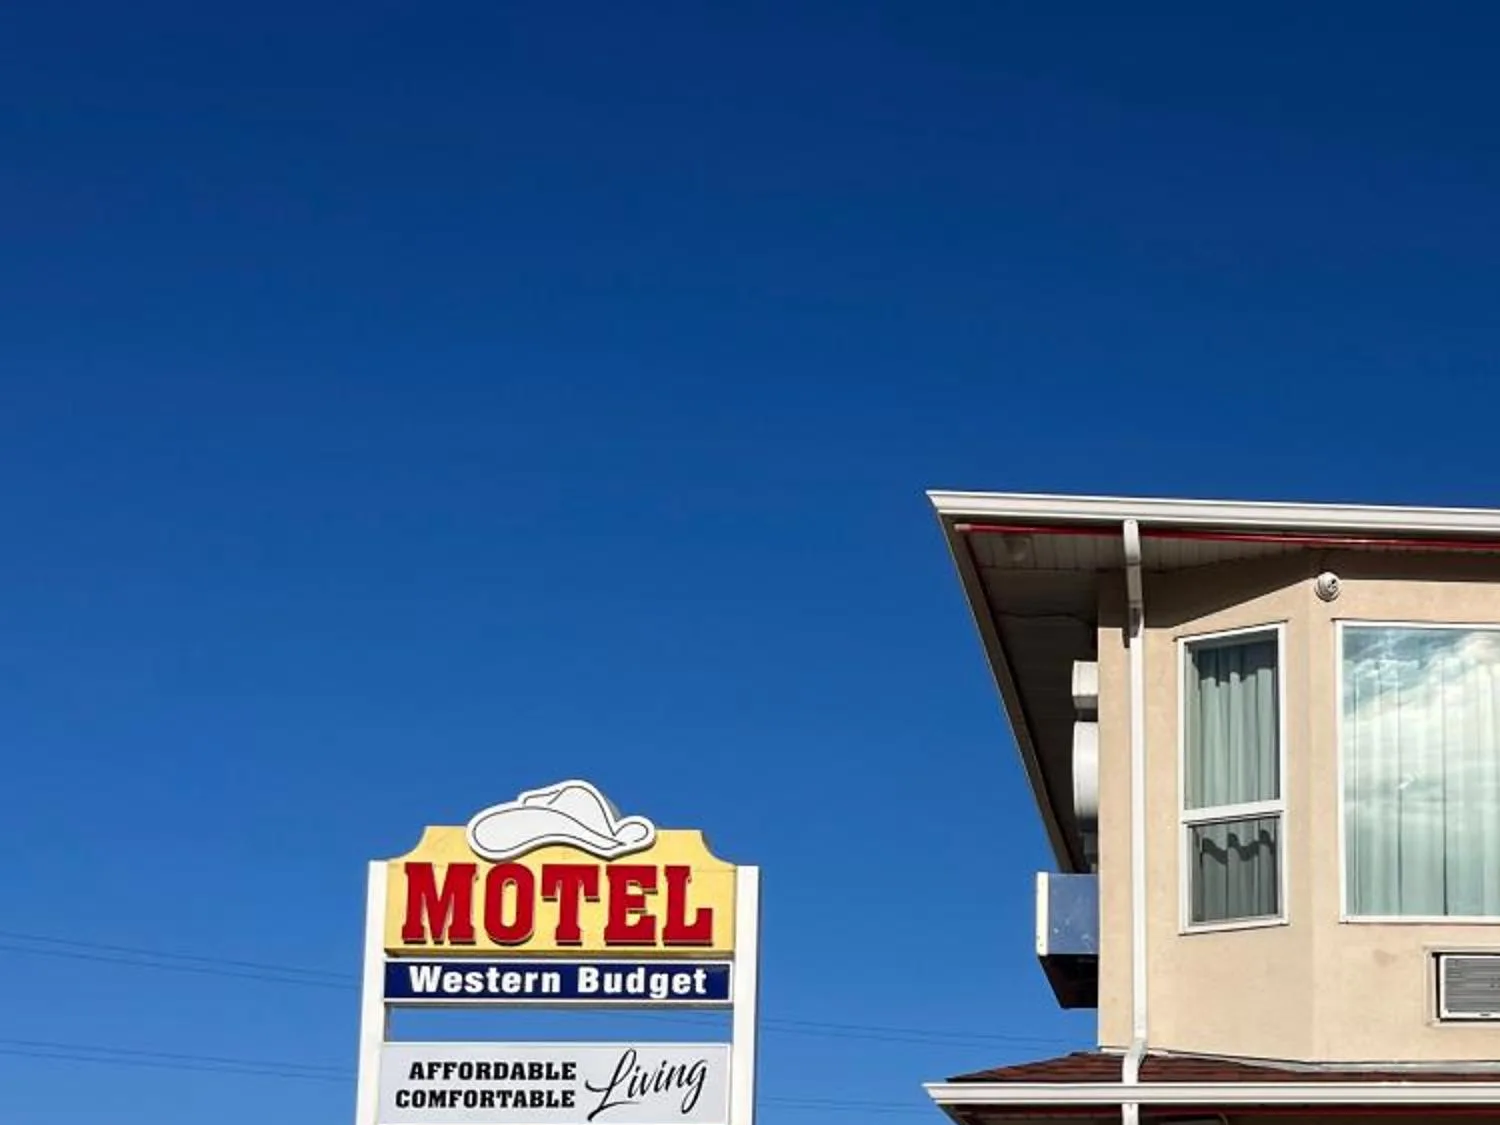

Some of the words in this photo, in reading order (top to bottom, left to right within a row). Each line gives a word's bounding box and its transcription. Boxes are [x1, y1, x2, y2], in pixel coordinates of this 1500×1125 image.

[402, 862, 714, 946] MOTEL
[410, 965, 560, 994] Western
[578, 967, 708, 998] Budget
[409, 1061, 577, 1081] AFFORDABLE
[585, 1048, 708, 1122] Living
[395, 1089, 575, 1109] COMFORTABLE
